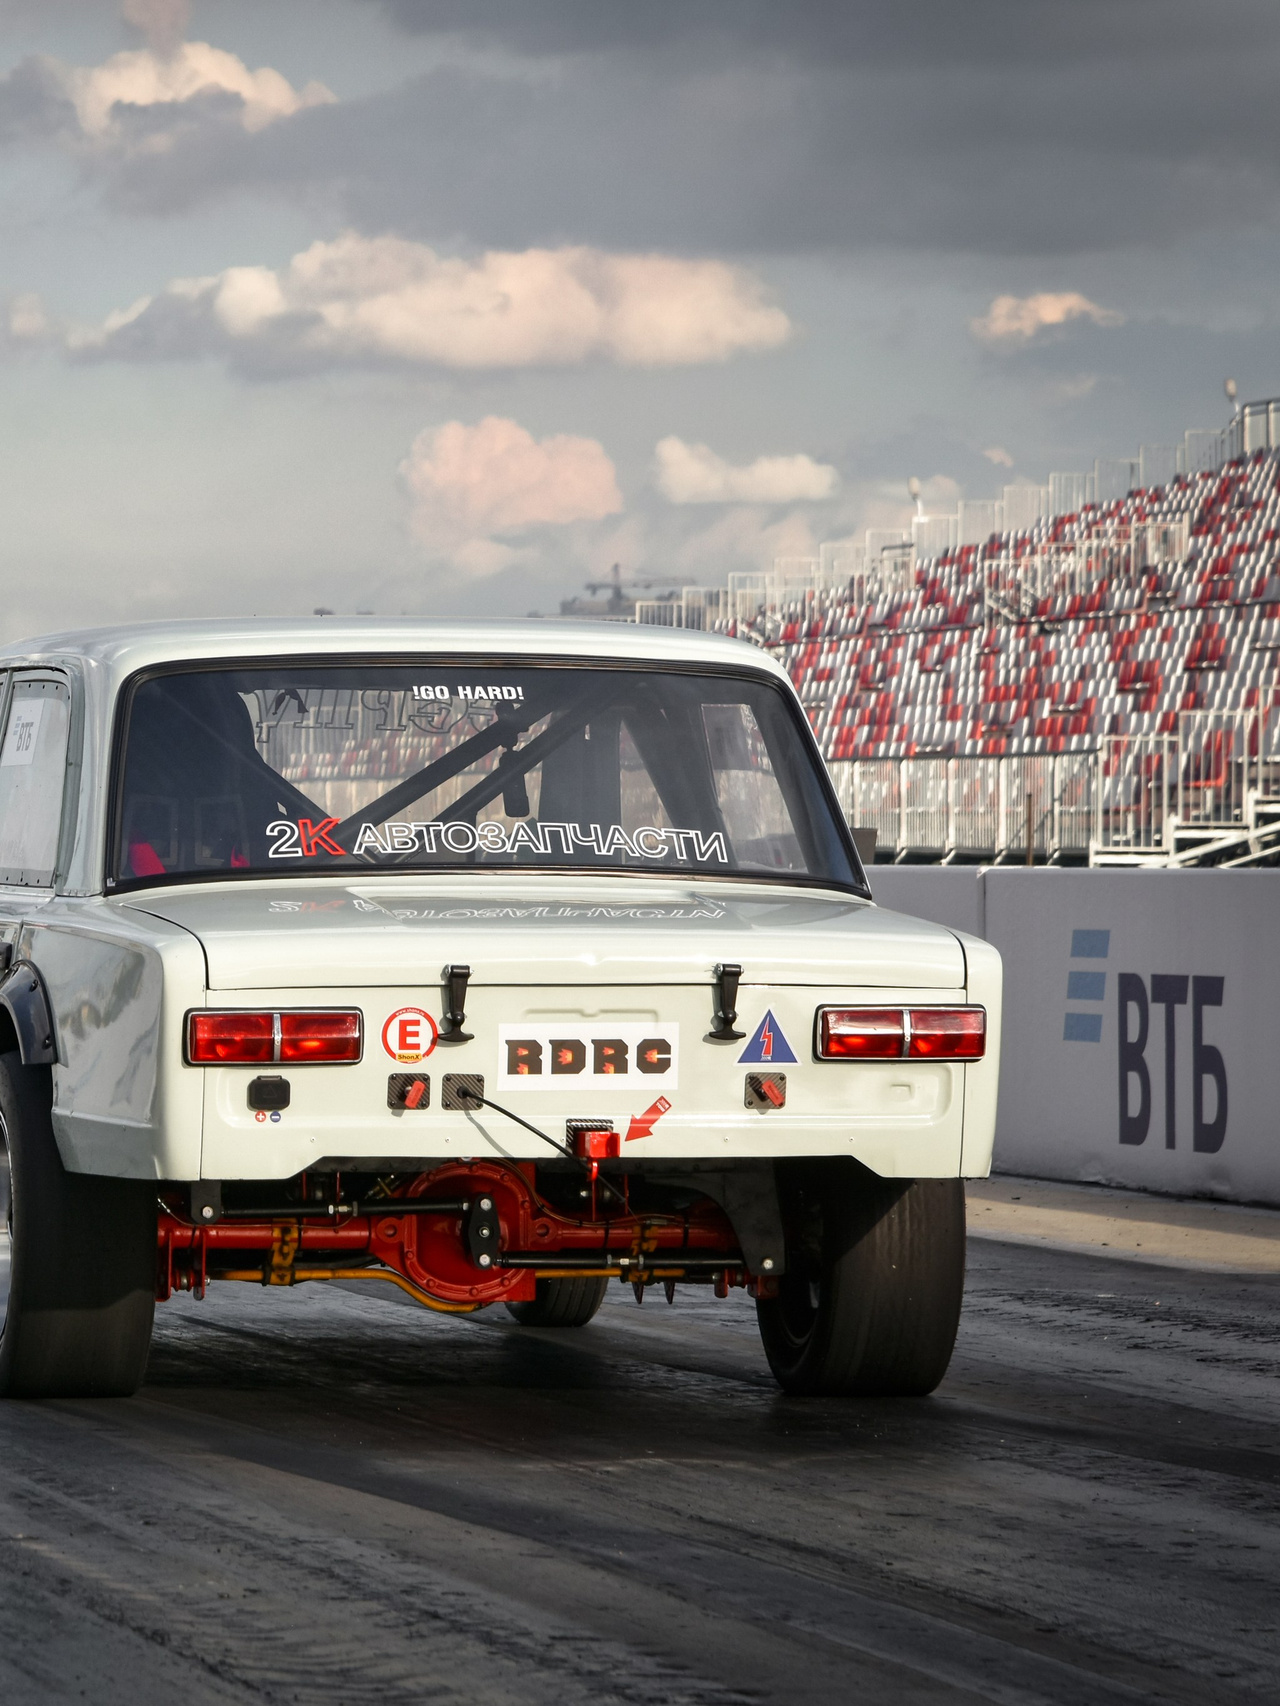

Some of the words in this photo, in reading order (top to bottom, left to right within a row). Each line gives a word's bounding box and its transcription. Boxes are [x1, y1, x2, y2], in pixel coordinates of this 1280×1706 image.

[413, 685, 450, 700] !GO
[457, 685, 524, 700] HARD!
[16, 722, 34, 752] ВТБ
[353, 821, 728, 863] АВТОЗАПЧАСТИ
[399, 1020, 421, 1050] E
[505, 1038, 671, 1075] RDRC
[1118, 973, 1228, 1154] ВТБ
